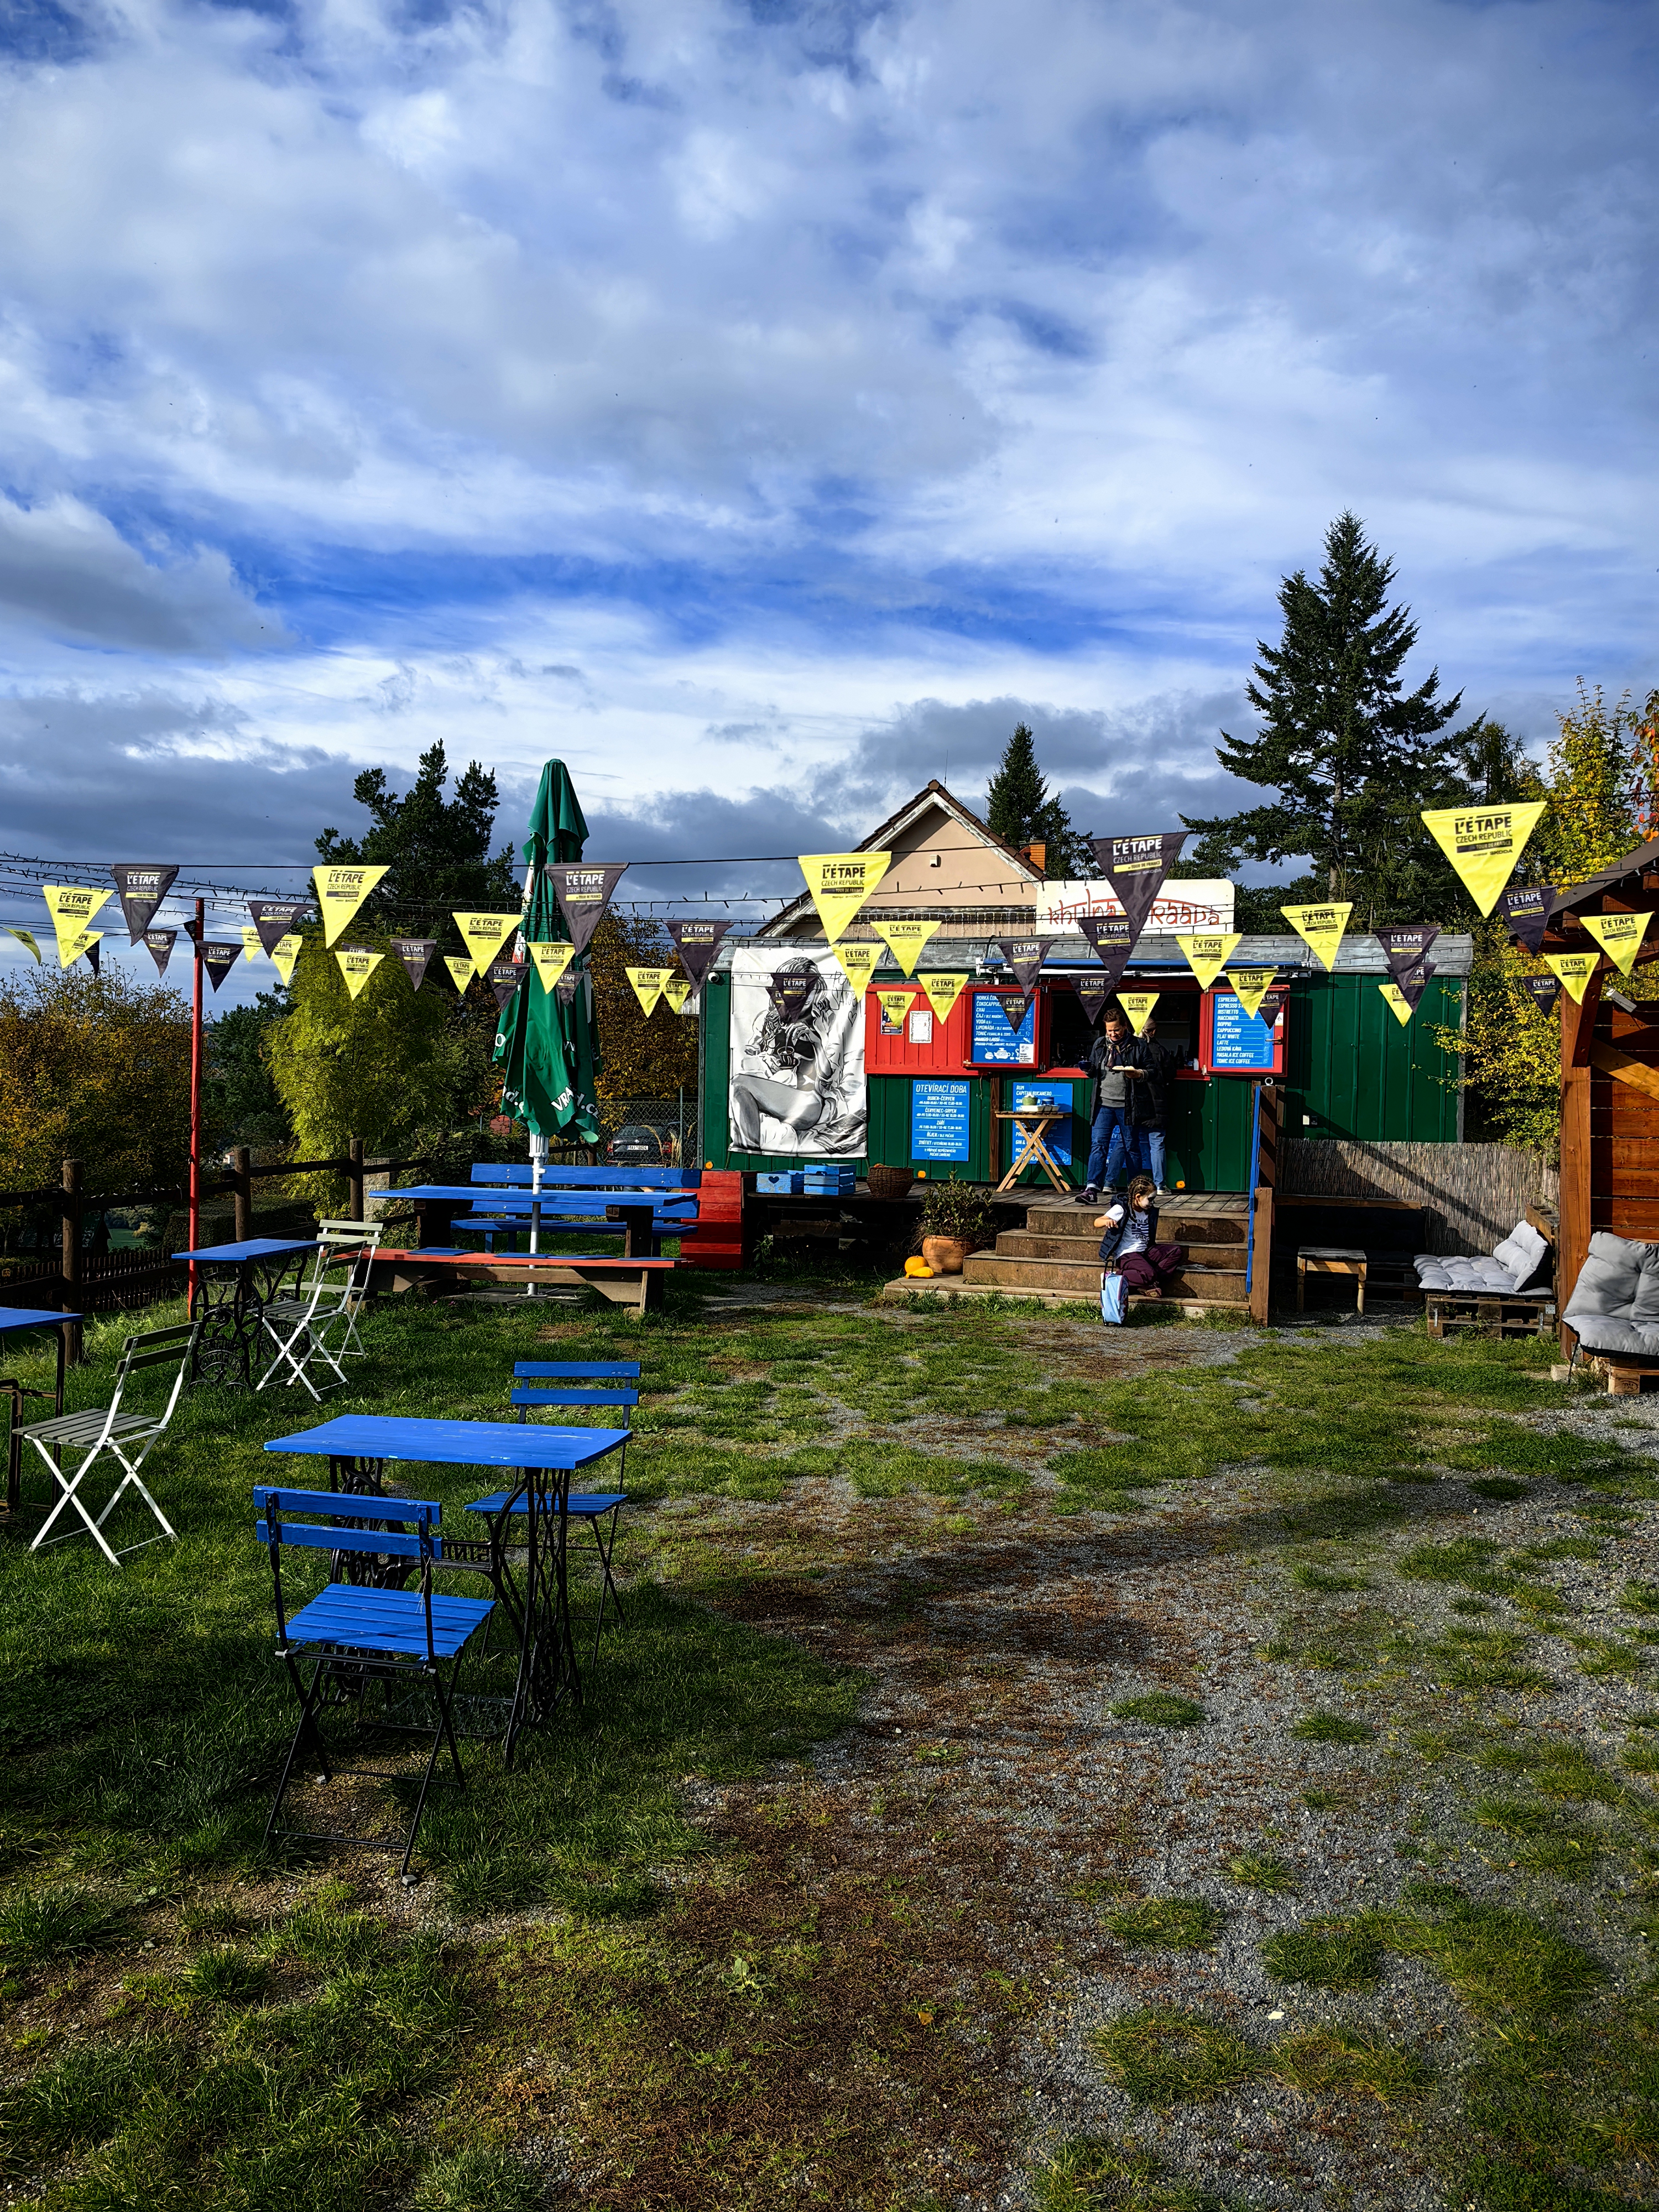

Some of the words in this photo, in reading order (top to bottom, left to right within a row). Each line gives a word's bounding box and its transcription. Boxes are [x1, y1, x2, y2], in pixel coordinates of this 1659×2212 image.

[1455, 835, 1477, 843] CZECH
[1479, 830, 1512, 841] REPUBLIC
[1113, 855, 1132, 864] CZECH
[1133, 851, 1162, 861] REPUBLIC
[916, 1083, 950, 1093] OTEVÍRACÍ
[950, 1085, 967, 1093] DOBA
